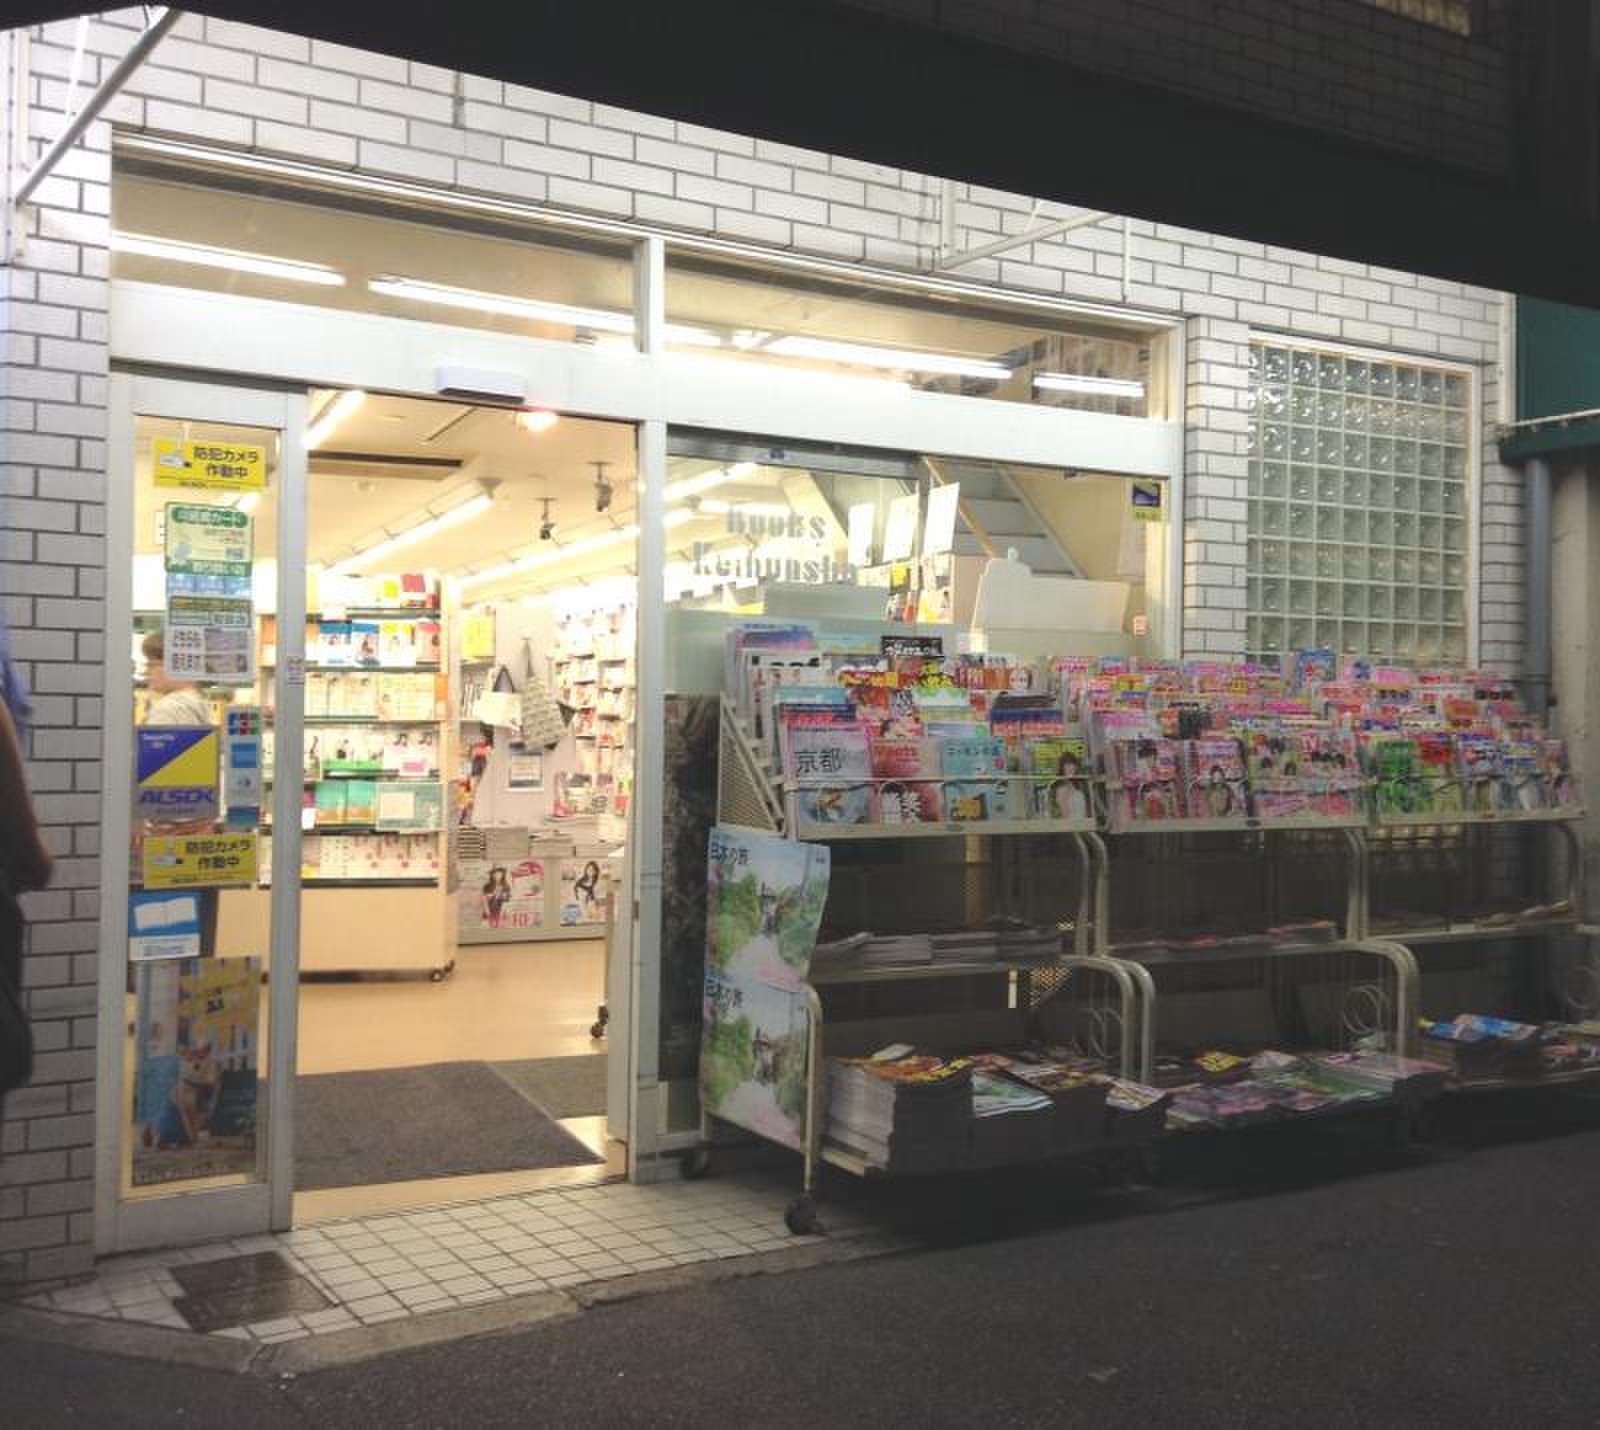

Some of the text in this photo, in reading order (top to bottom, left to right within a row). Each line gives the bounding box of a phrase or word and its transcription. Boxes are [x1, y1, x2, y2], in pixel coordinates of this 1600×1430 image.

[193, 446, 258, 464] 防犯カメラ
[206, 463, 249, 478] 作動中
[726, 507, 826, 540] Books
[794, 748, 842, 773] 京都
